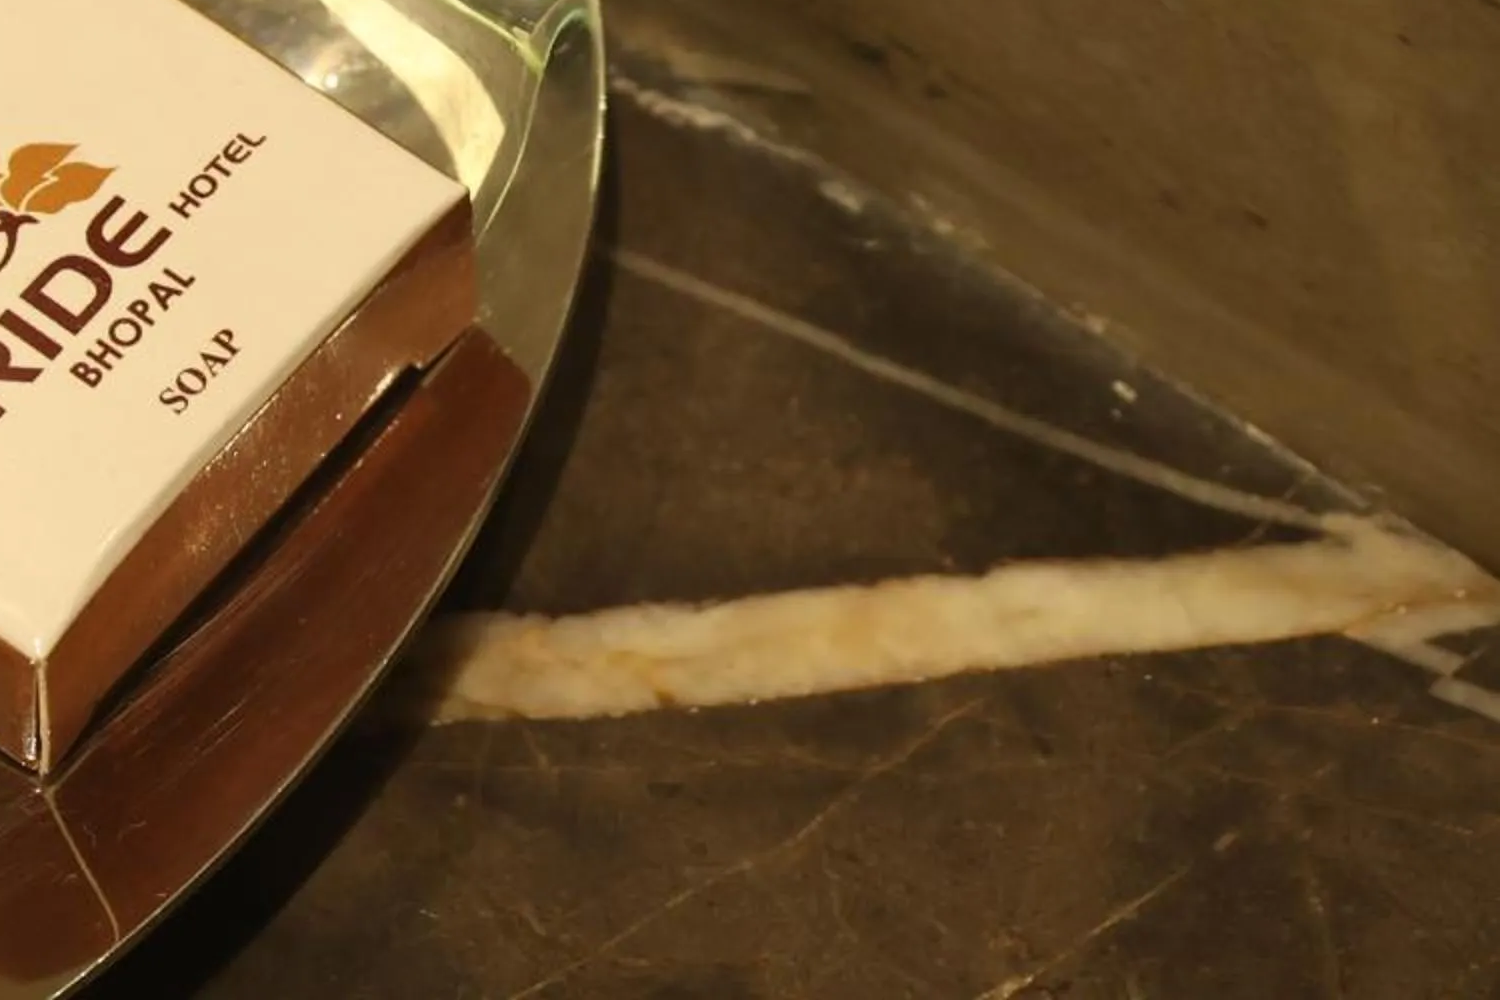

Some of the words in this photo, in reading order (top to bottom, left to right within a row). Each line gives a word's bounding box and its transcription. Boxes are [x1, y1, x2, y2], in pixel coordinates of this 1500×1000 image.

[169, 131, 268, 220] HOTEL
[68, 266, 196, 389] BHOPAL
[158, 327, 243, 416] SOAP
